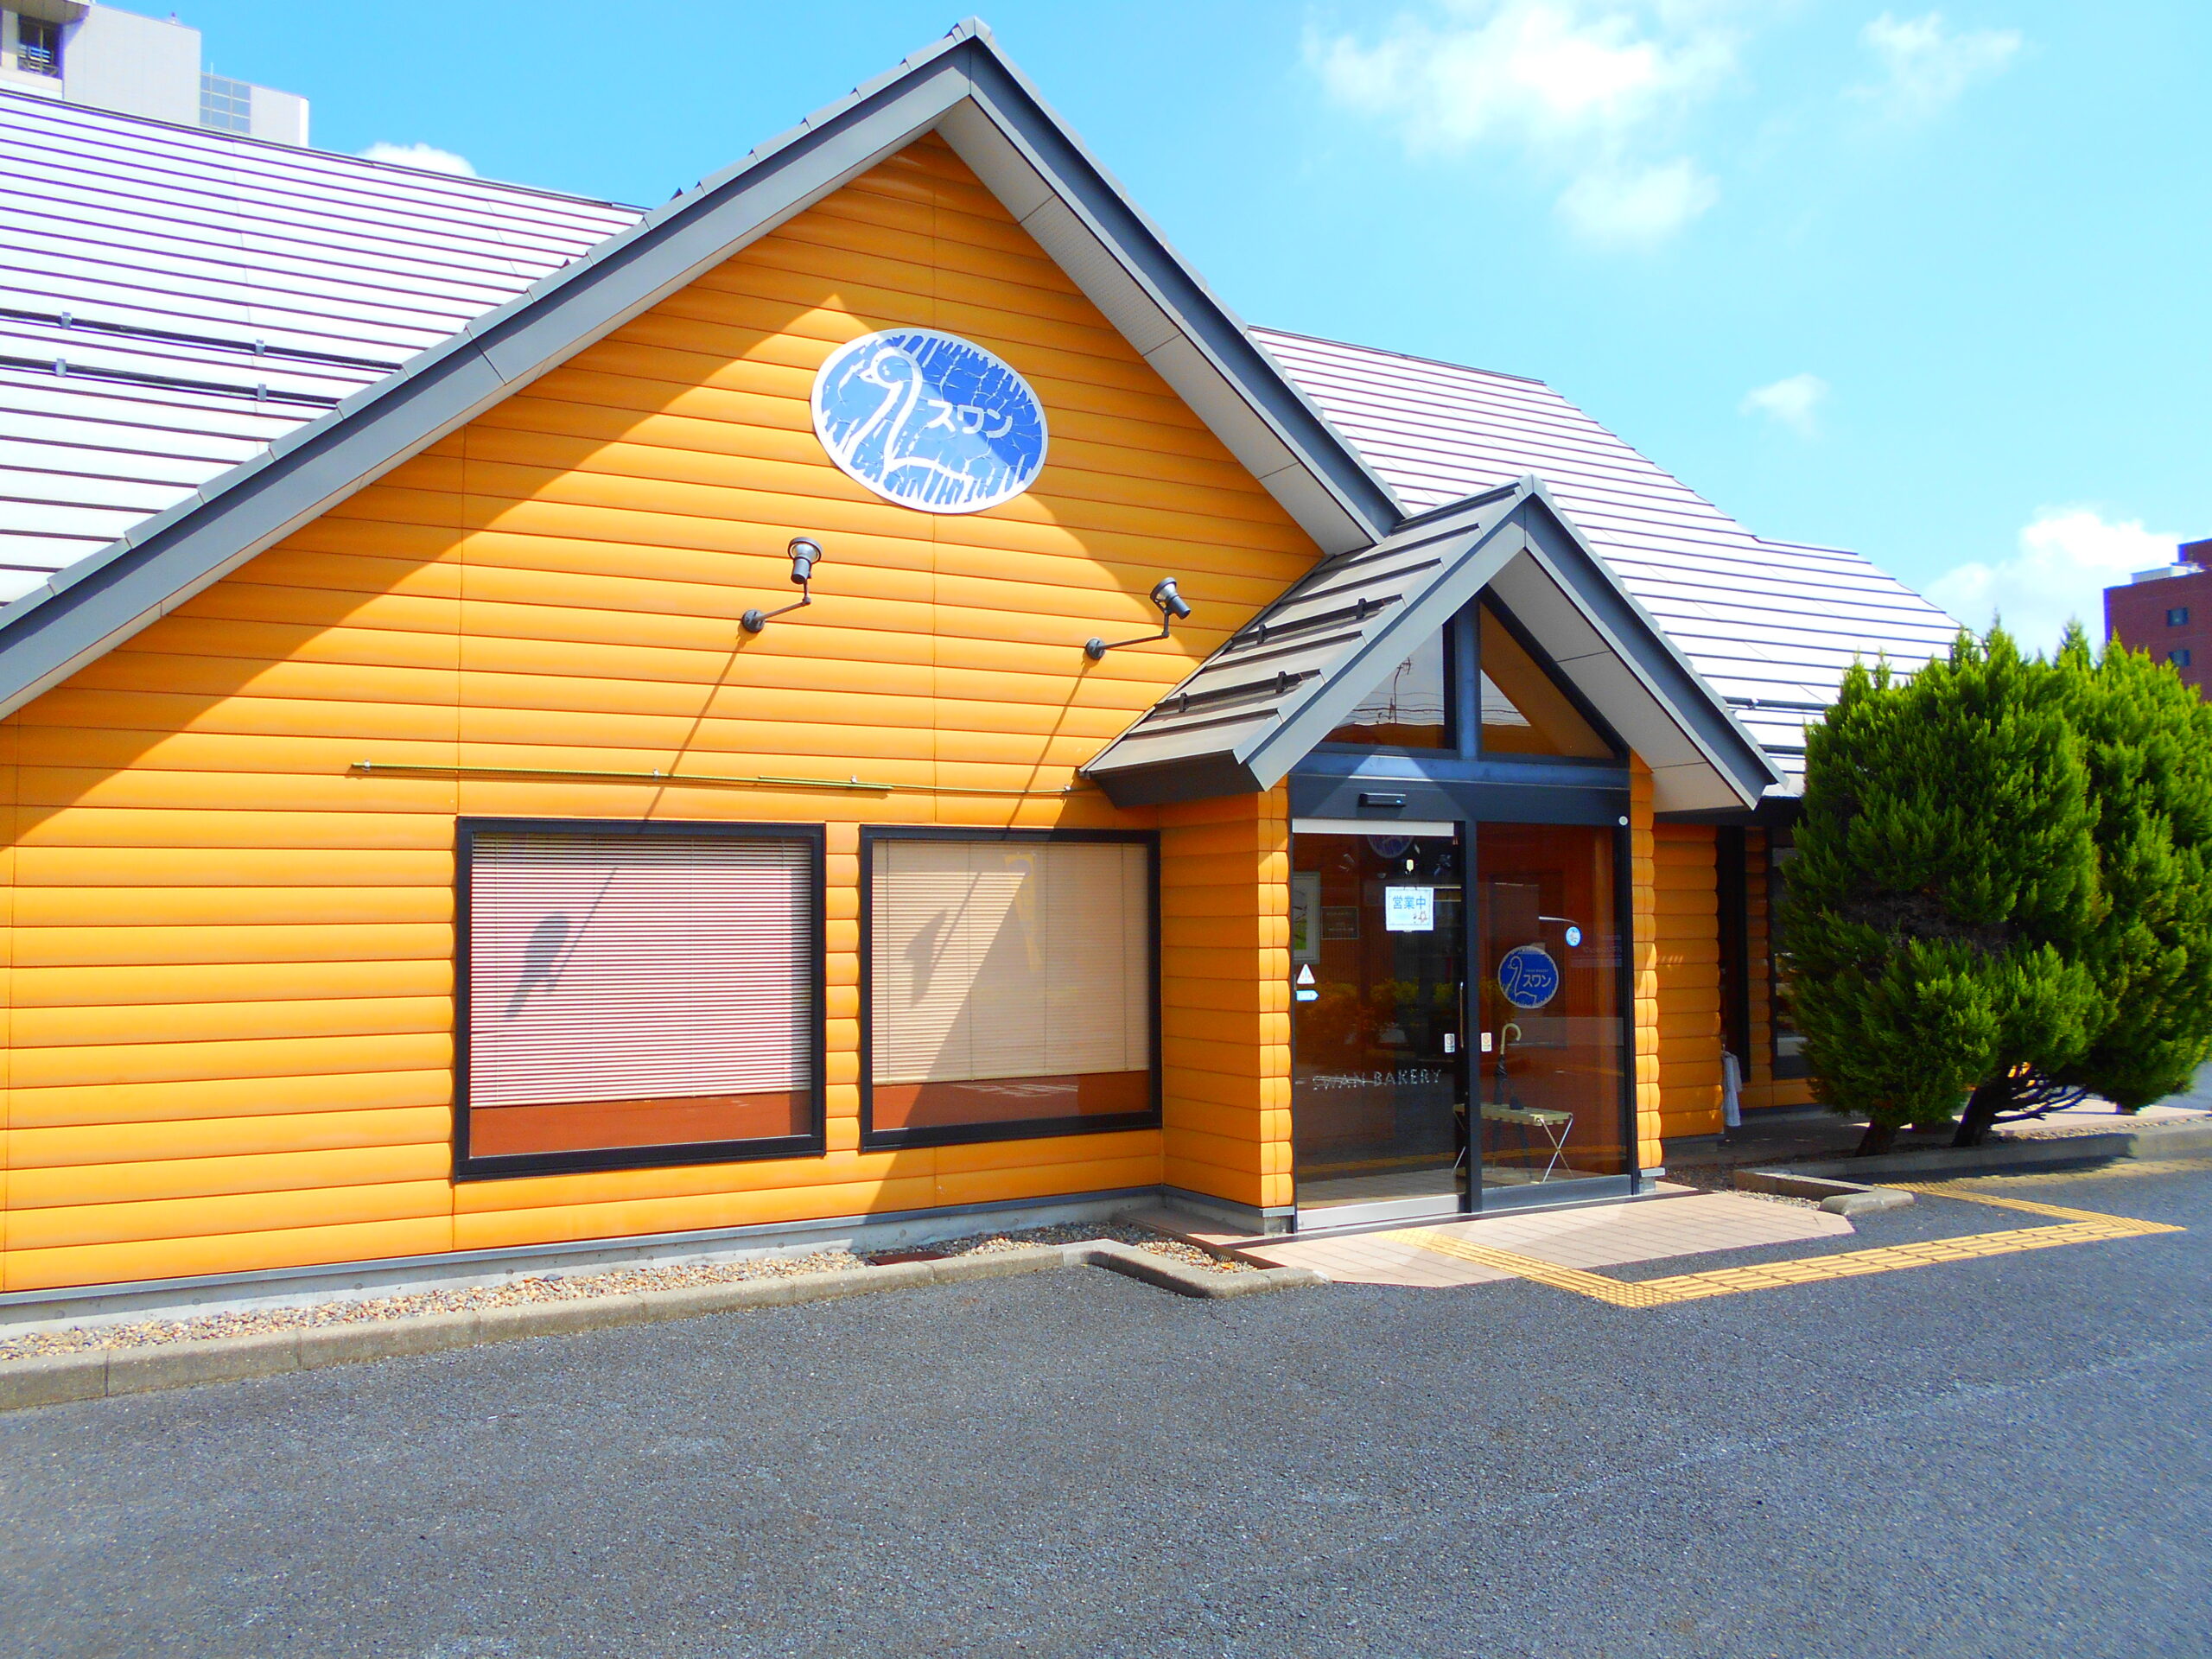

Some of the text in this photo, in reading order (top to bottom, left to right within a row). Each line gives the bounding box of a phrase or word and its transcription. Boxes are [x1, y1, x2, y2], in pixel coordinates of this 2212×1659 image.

[927, 399, 1013, 439] スワン
[1393, 895, 1427, 910] 営業中
[1522, 974, 1551, 988] スワン
[1373, 1069, 1442, 1087] BAKERY
